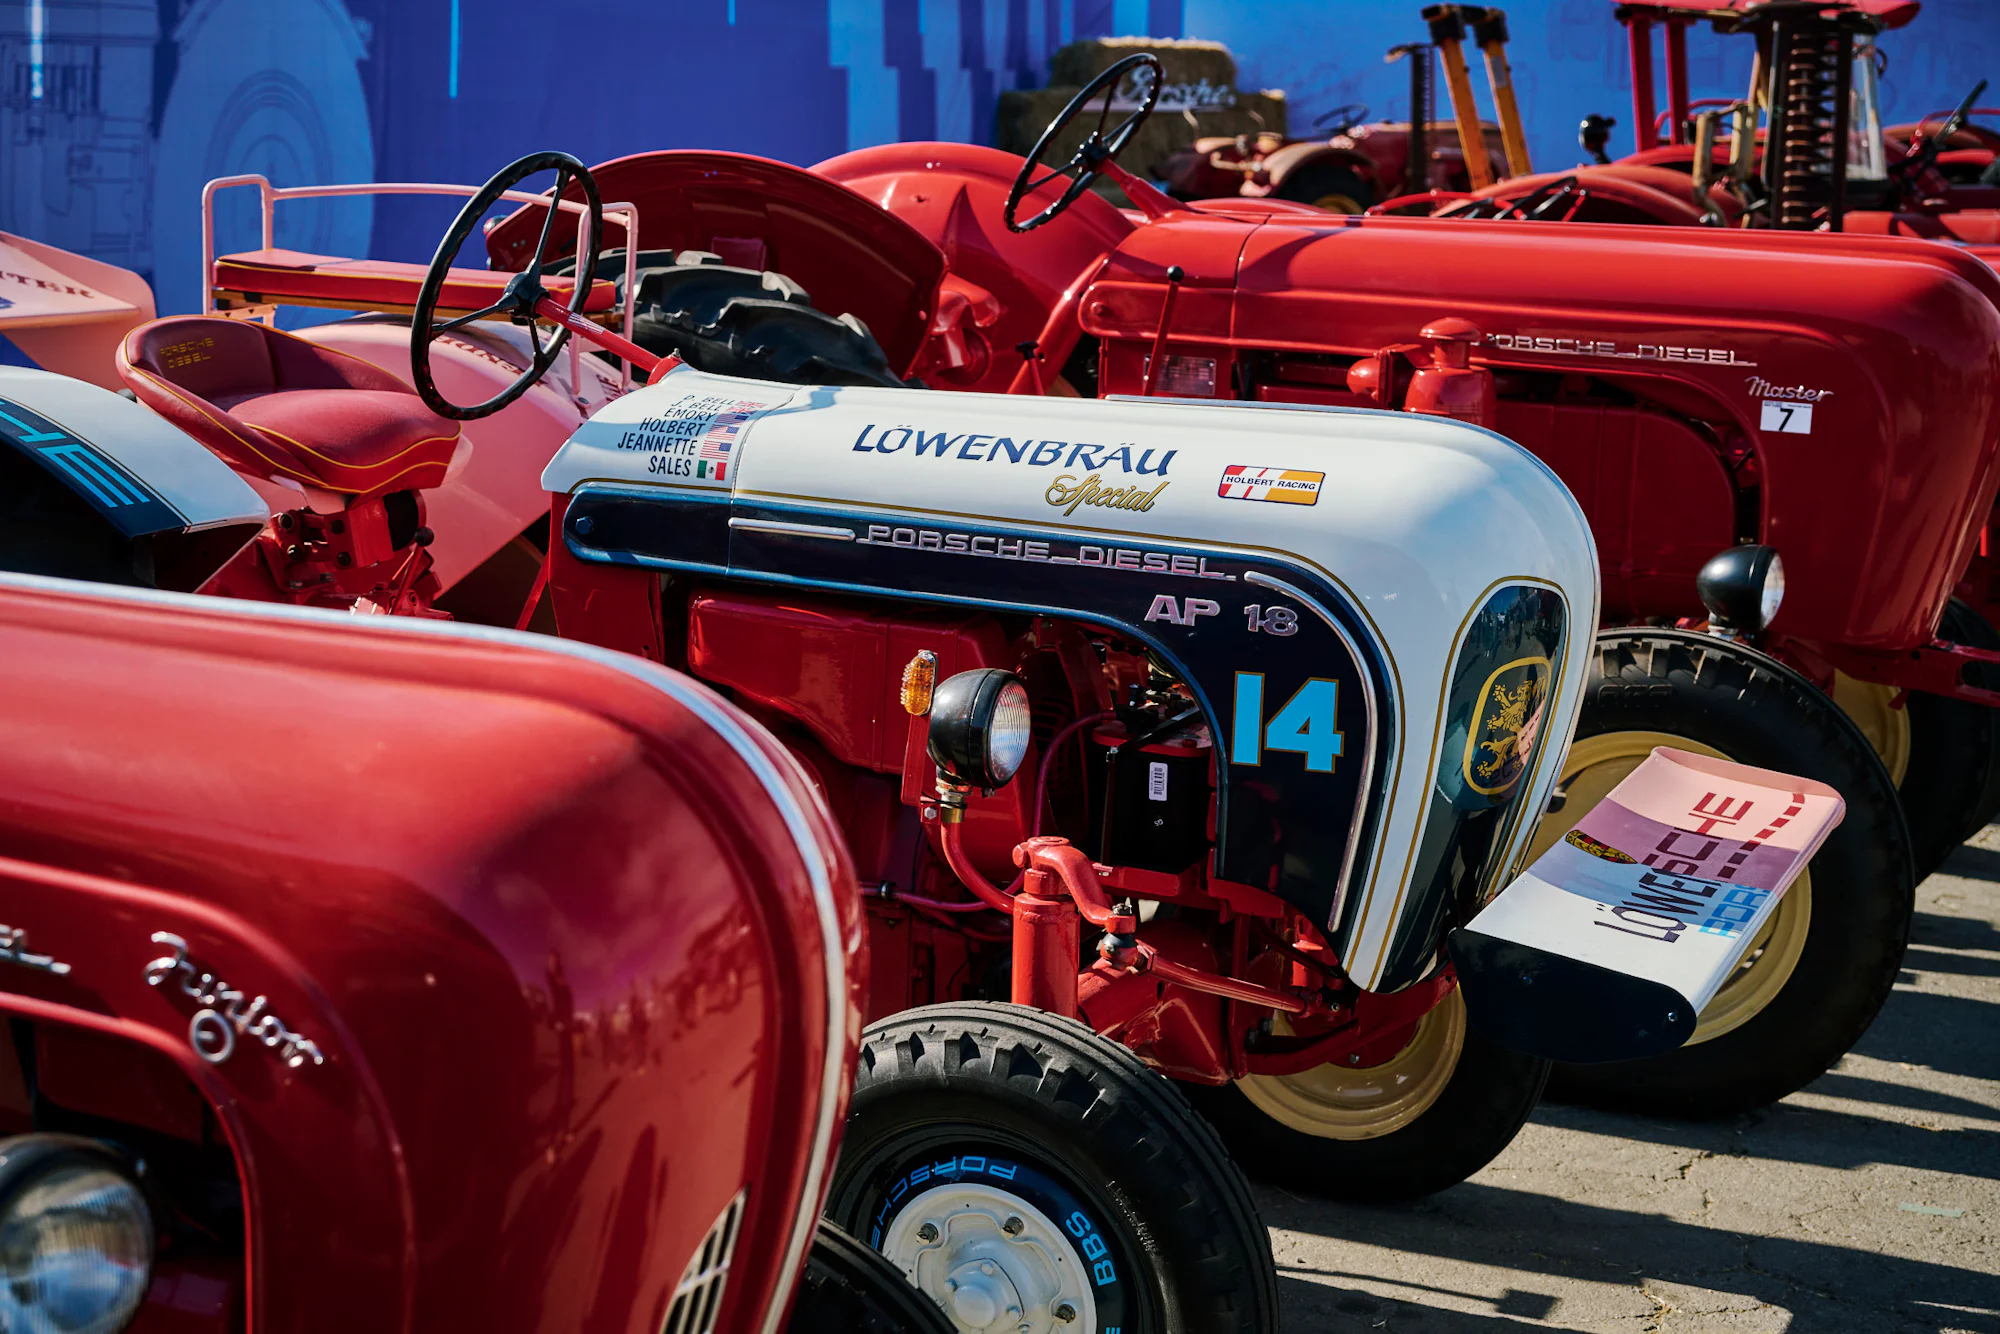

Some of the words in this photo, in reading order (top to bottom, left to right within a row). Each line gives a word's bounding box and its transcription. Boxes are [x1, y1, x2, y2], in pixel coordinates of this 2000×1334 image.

[1486, 332, 1616, 358] ORSCHE
[1637, 343, 1750, 366] DIESEL
[702, 396, 735, 405] BELL
[1744, 375, 1834, 402] Master
[664, 407, 718, 422] EMORY
[688, 402, 722, 411] BELL
[1778, 407, 1795, 431] 7
[639, 417, 706, 437] HOLBERT
[617, 432, 698, 456] JEANNETTE
[851, 424, 1179, 477] LÖWENBRÄU
[648, 455, 692, 477] SALES
[1045, 473, 1171, 517] Special
[1226, 476, 1275, 487] HOLBERT
[1277, 480, 1317, 490] RACING
[867, 524, 1051, 561] PORSCHE
[1078, 545, 1227, 579] DIESEL
[1144, 594, 1221, 627] AP
[1243, 603, 1299, 637] 18
[1231, 670, 1345, 774] 14
[143, 930, 324, 1068] Junior
[870, 1155, 1018, 1251] PORSCHE
[1065, 1210, 1117, 1287] BBS
